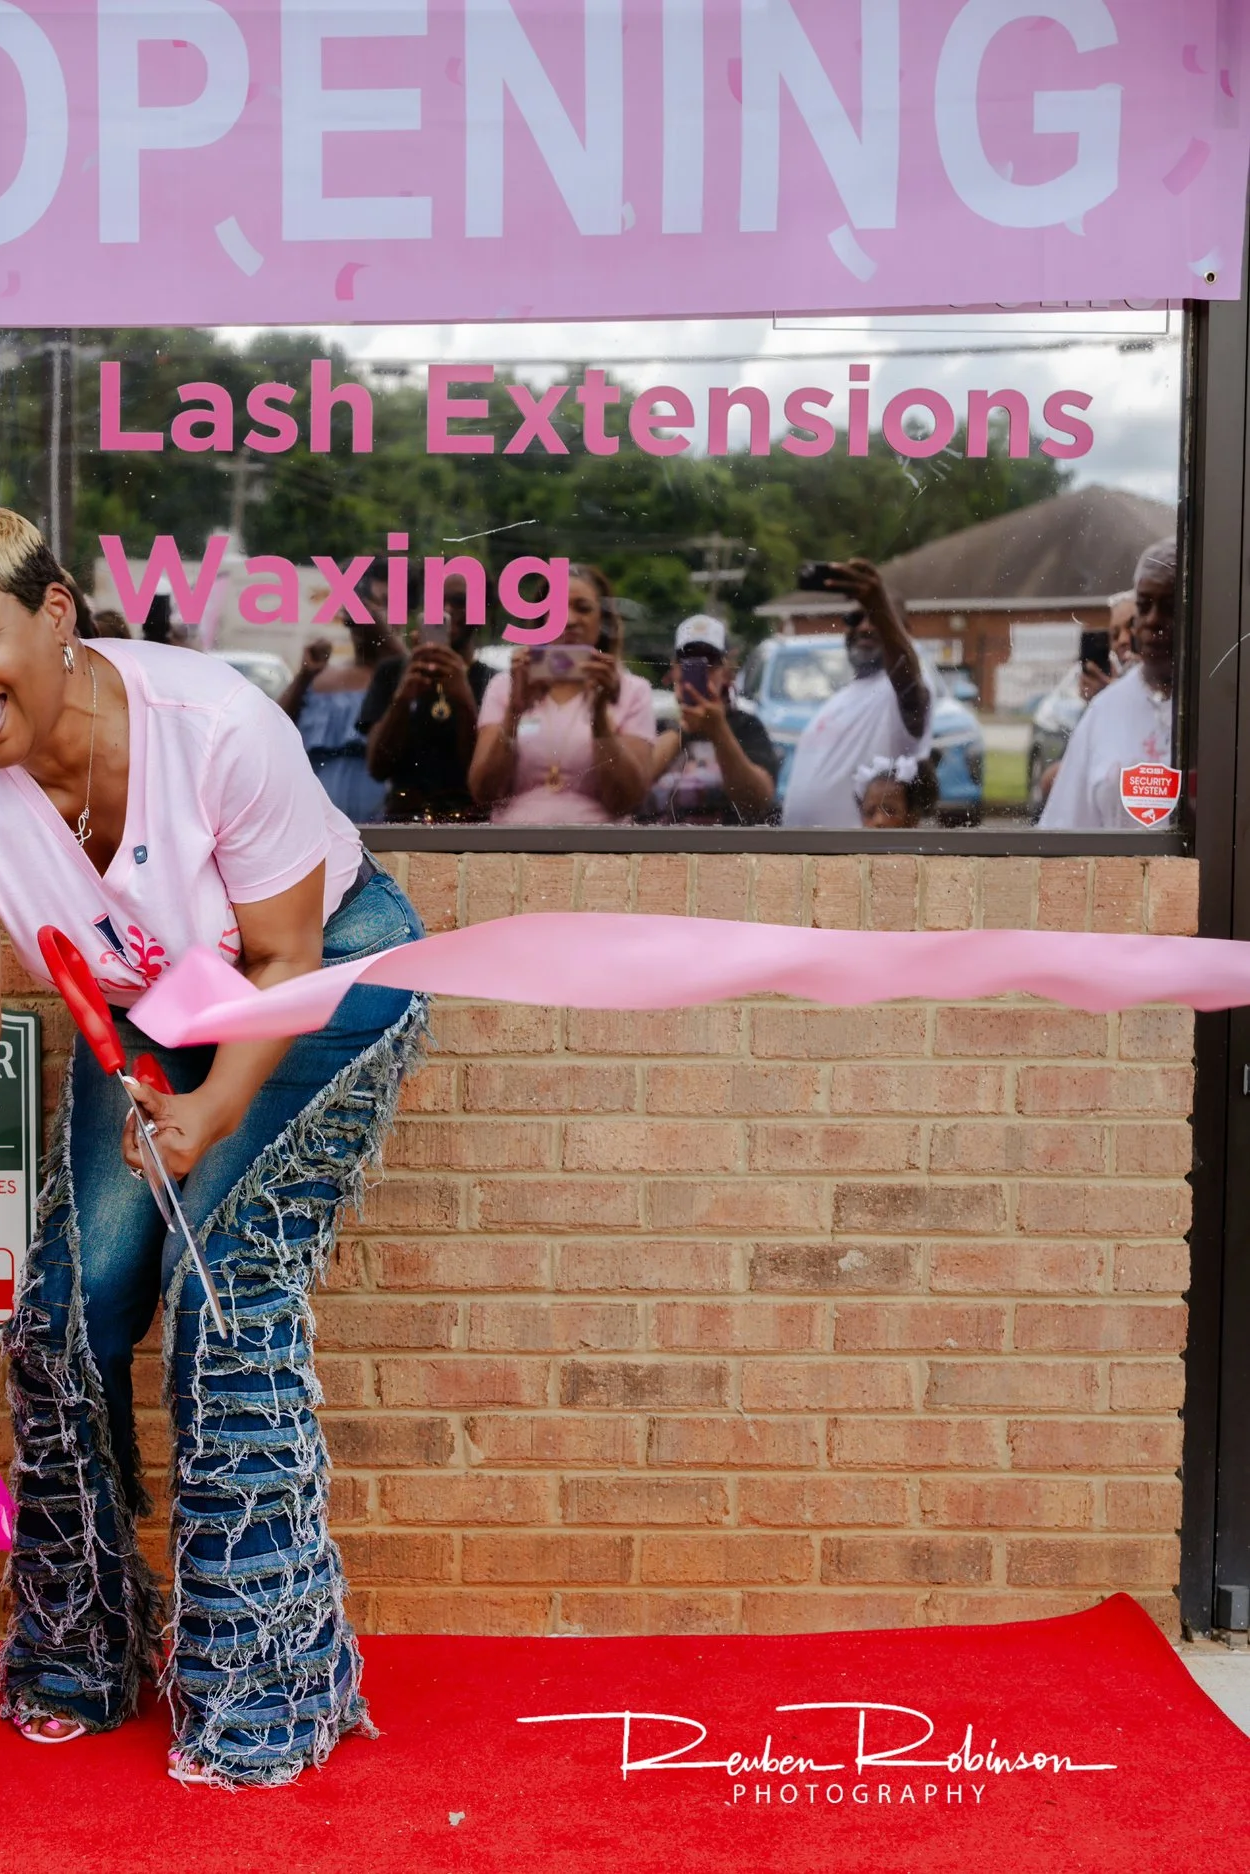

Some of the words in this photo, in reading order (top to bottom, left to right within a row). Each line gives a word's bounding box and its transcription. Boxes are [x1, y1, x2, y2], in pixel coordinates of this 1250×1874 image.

[100, 360, 374, 453] Lash
[427, 364, 1094, 460] Extensions
[99, 532, 570, 645] Waxing
[1130, 777, 1172, 786] SECURITY
[1132, 786, 1168, 795] SYSTEM
